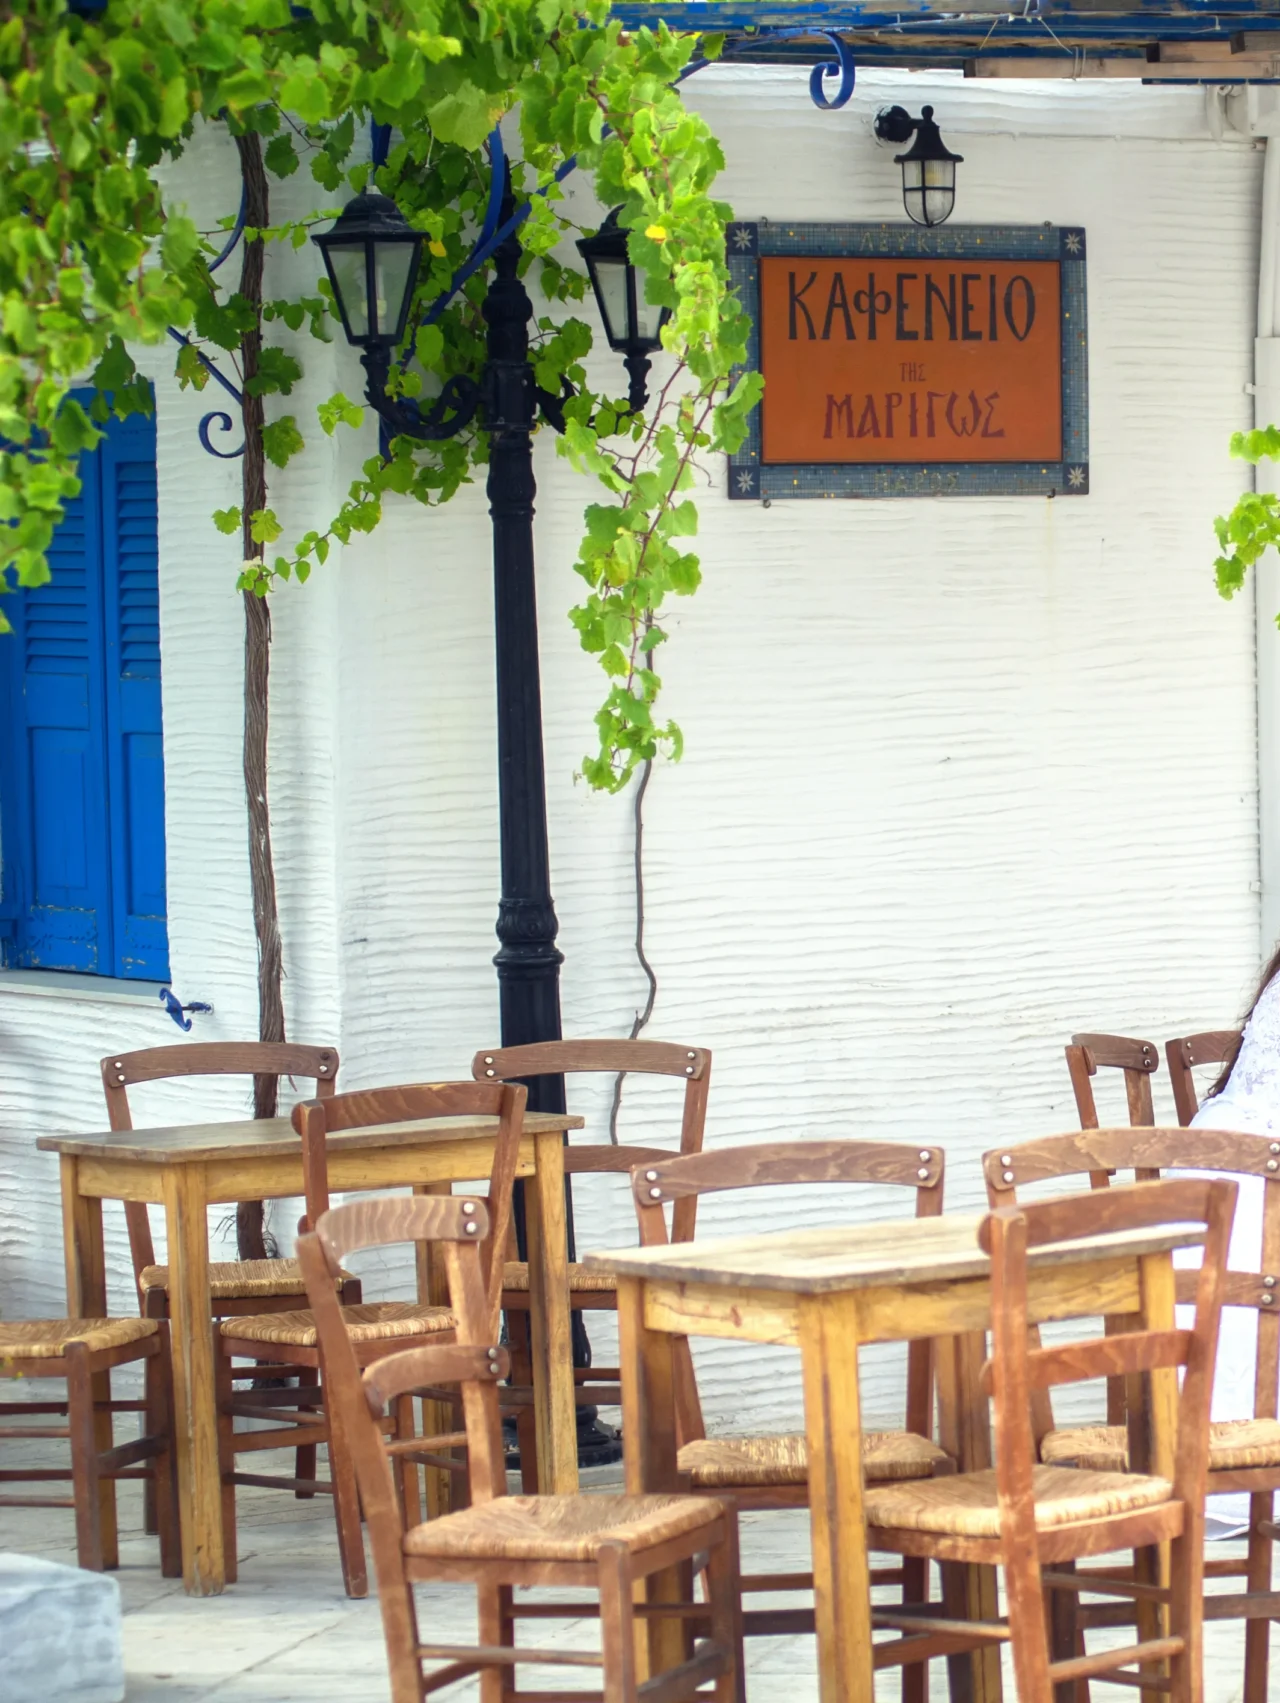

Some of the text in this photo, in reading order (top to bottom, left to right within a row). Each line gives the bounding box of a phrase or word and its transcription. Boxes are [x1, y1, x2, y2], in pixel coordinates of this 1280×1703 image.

[788, 271, 1036, 342] ΚΑΦΕΝΕΙΟ
[900, 362, 927, 382] ΤΗΣ
[823, 390, 1005, 439] ΜΑΡΙΓΩΣ
